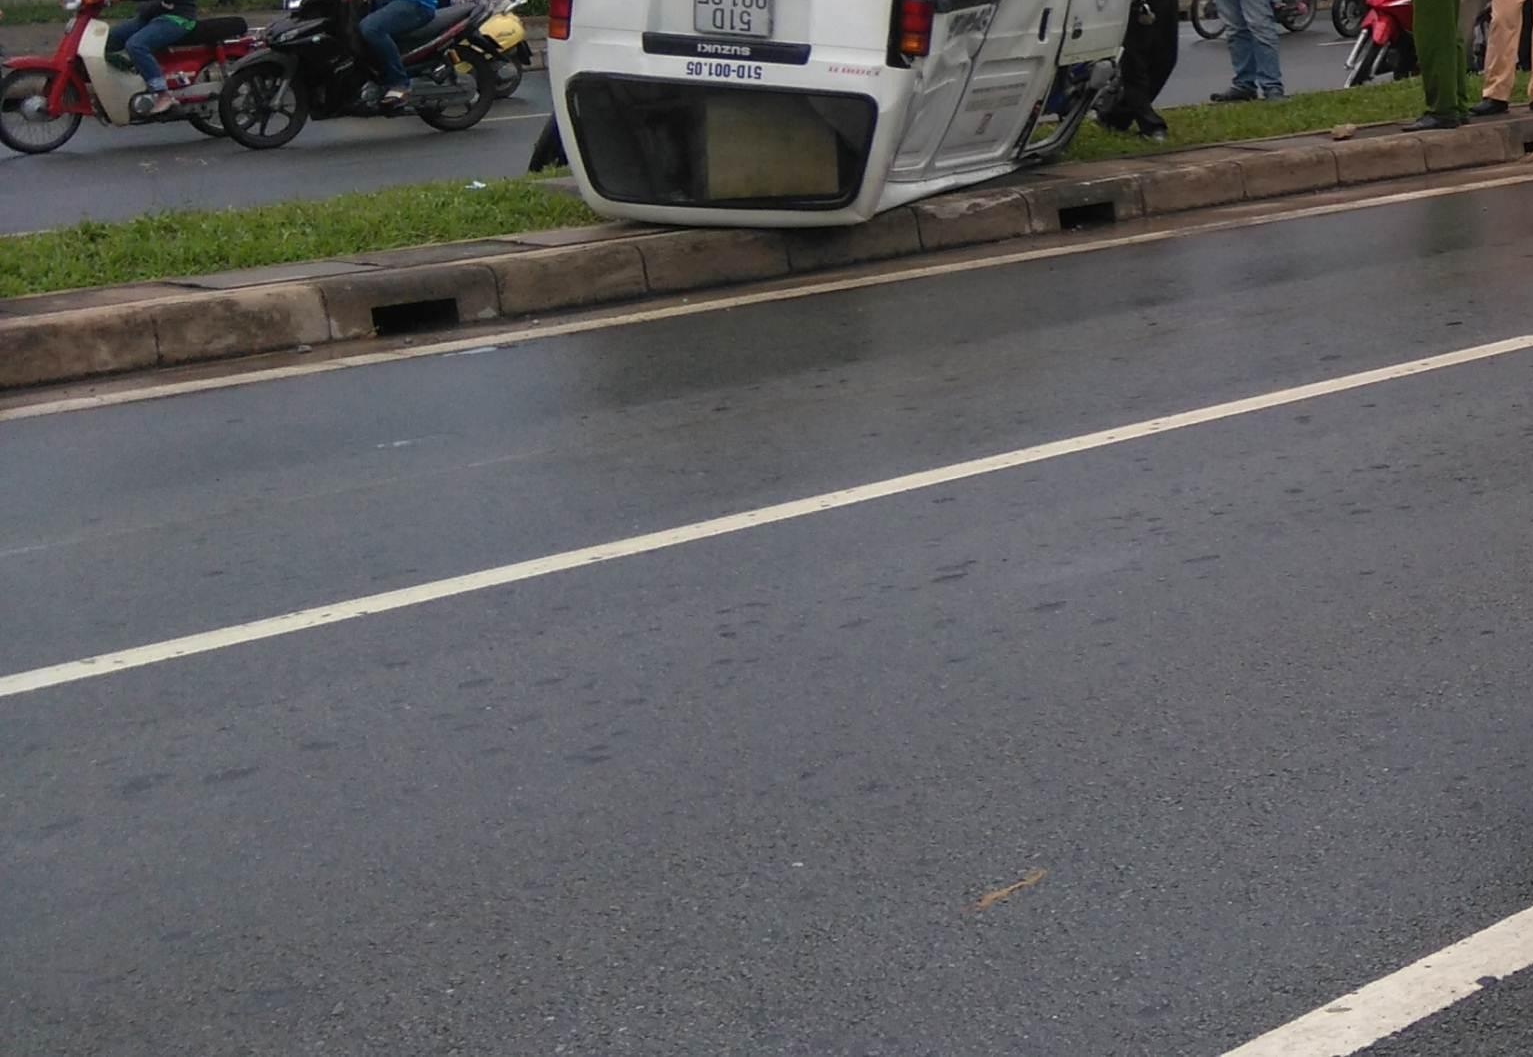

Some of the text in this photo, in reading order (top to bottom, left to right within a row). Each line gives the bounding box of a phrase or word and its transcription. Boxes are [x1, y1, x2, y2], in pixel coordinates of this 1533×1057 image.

[712, 8, 752, 32] 51D
[697, 43, 752, 56] SUZUKI
[686, 61, 763, 79] 51D-001.05
